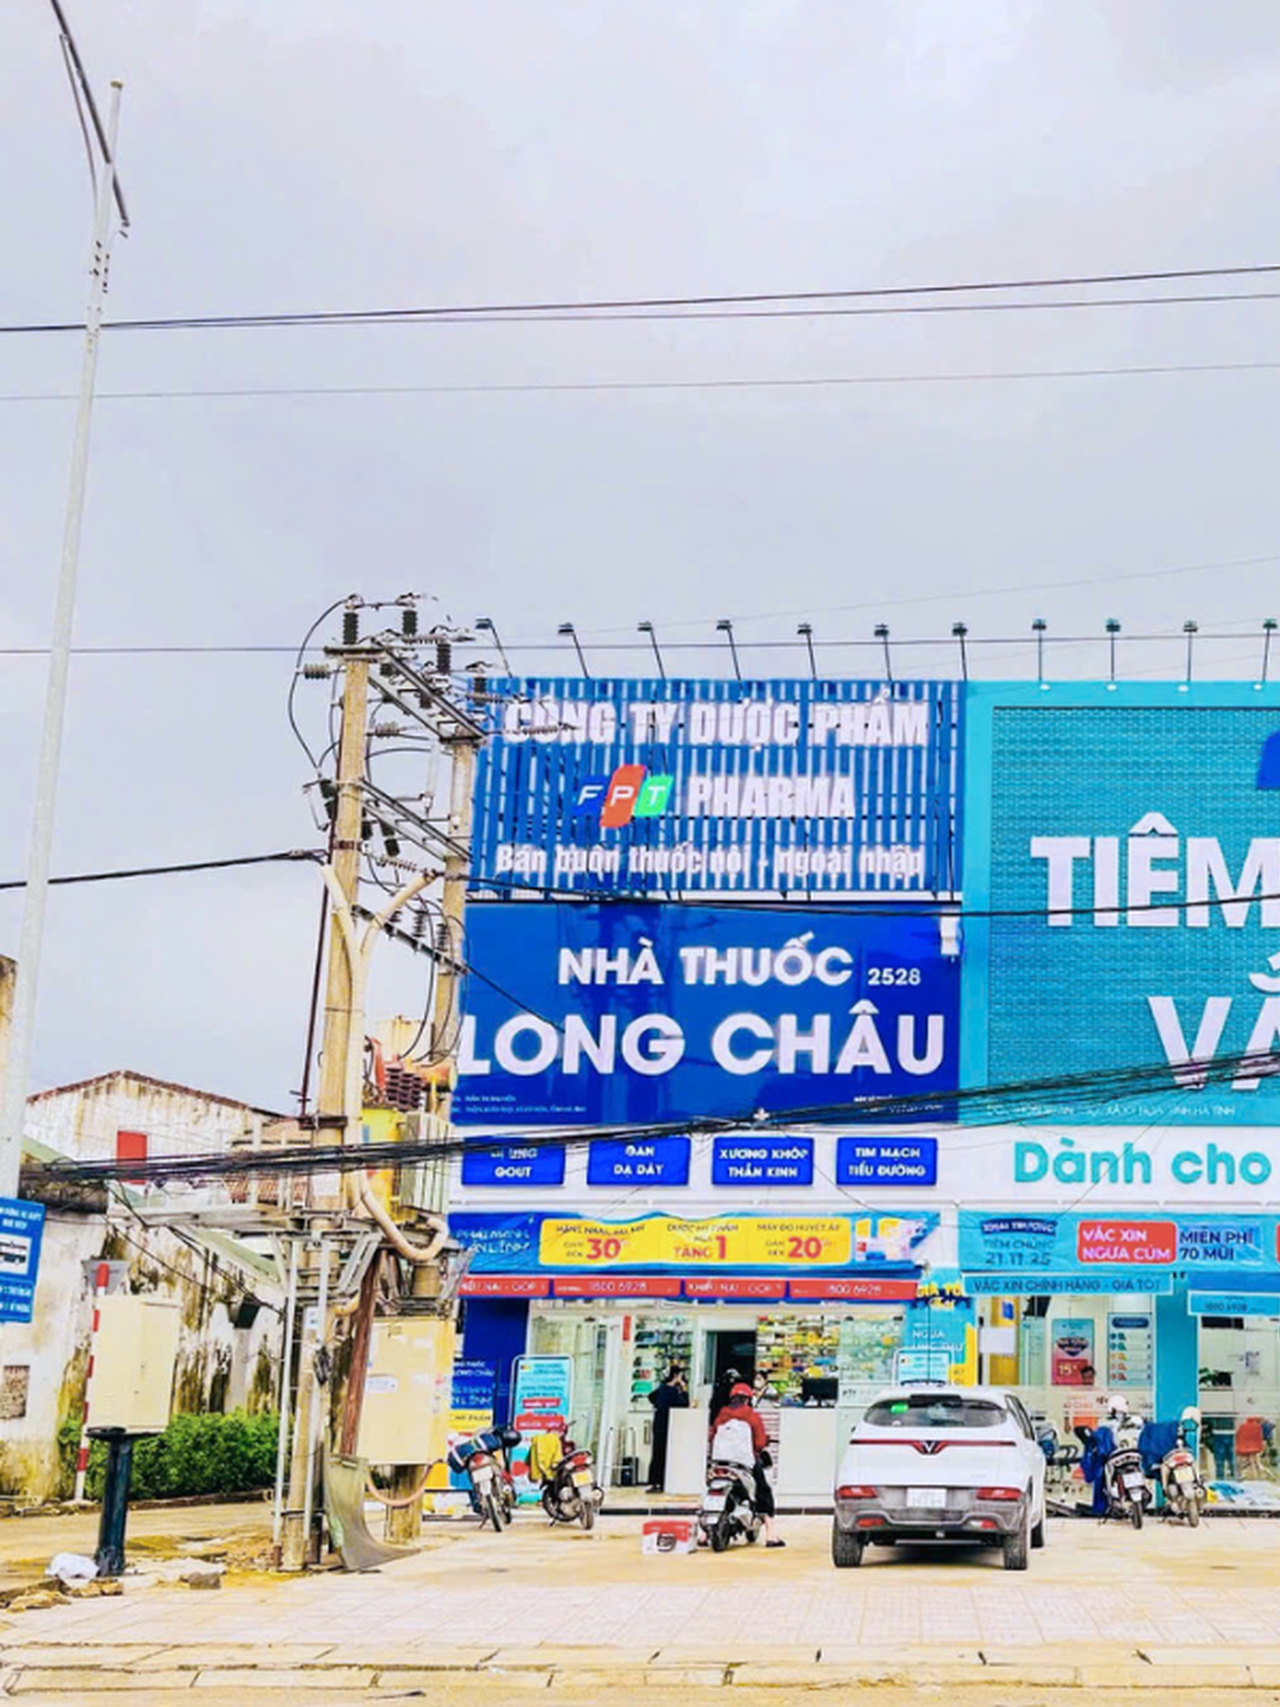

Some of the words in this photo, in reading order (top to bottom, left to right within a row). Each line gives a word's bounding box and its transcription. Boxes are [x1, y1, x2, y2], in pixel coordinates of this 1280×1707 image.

[630, 703, 680, 744] TY
[689, 697, 799, 752] DƯỢC
[687, 775, 856, 817] PHARMA
[559, 937, 664, 986] NHÀ
[680, 932, 853, 987] THUỐC
[867, 967, 921, 986] 2528
[455, 1012, 685, 1077] LONG
[711, 999, 944, 1076] CHÂU
[625, 1145, 655, 1158] GAN
[855, 1147, 877, 1158] TIM
[880, 1147, 921, 1161] MẠCH
[1014, 1137, 1152, 1184] Dành
[1171, 1143, 1272, 1185] cho
[494, 1166, 533, 1180] GOUT
[613, 1164, 633, 1178] DẠ
[766, 1166, 798, 1178] KINH
[1120, 1229, 1148, 1242] XIN
[1225, 1226, 1254, 1244] PHÍ
[714, 1235, 727, 1260] 1
[1133, 1244, 1171, 1260] CÚM
[1180, 1247, 1199, 1260] 70
[1003, 1278, 1023, 1291] XIN
[1025, 1277, 1063, 1292] CHÍNH
[1065, 1278, 1100, 1292] HÀNG
